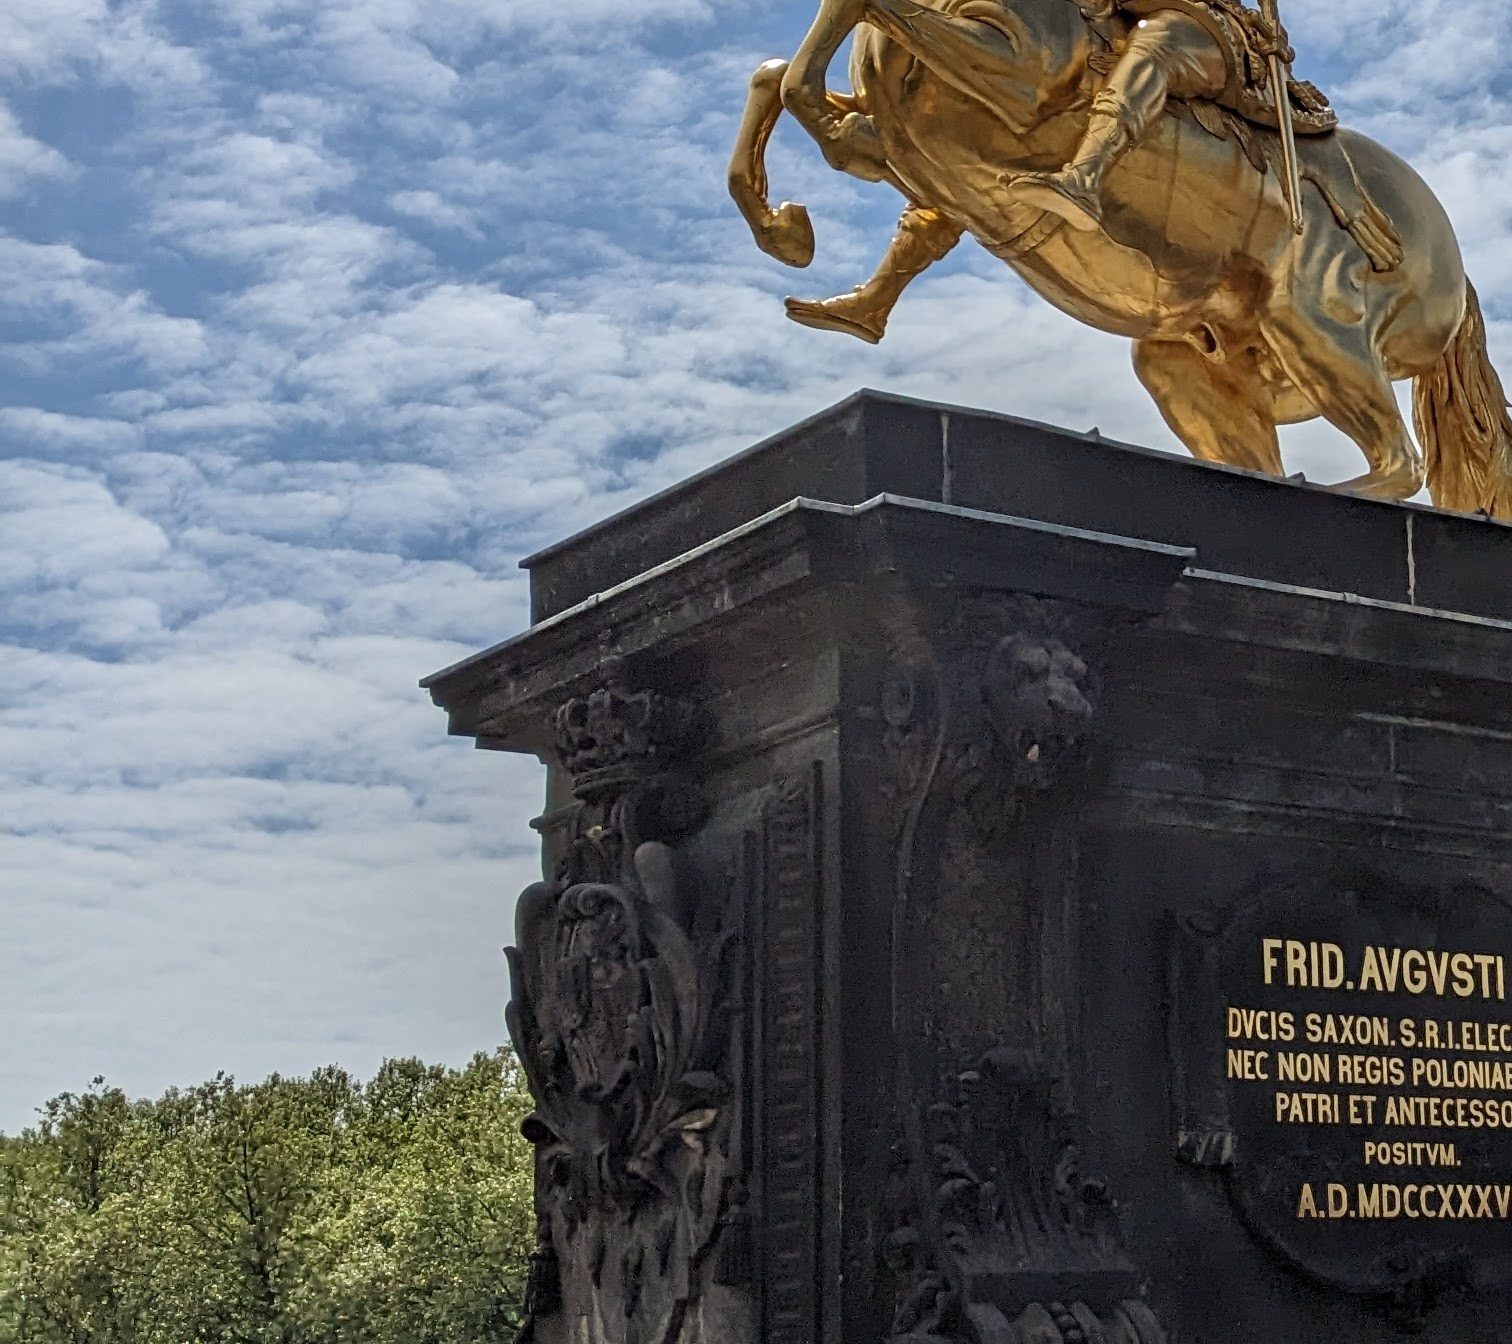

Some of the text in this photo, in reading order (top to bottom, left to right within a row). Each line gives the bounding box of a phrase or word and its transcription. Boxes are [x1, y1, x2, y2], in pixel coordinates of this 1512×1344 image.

[1262, 938, 1354, 990] FRID.
[1359, 945, 1505, 1000] AVGVSTI
[1228, 1007, 1295, 1041] DVCIS
[1305, 1012, 1396, 1047] SAXON.
[1227, 1048, 1269, 1080] NEC
[1277, 1051, 1331, 1083] NON
[1337, 1054, 1405, 1086] REGIS
[1275, 1092, 1340, 1124] PATRI
[1349, 1094, 1377, 1125] ET
[1364, 1141, 1462, 1166] POSITVM.
